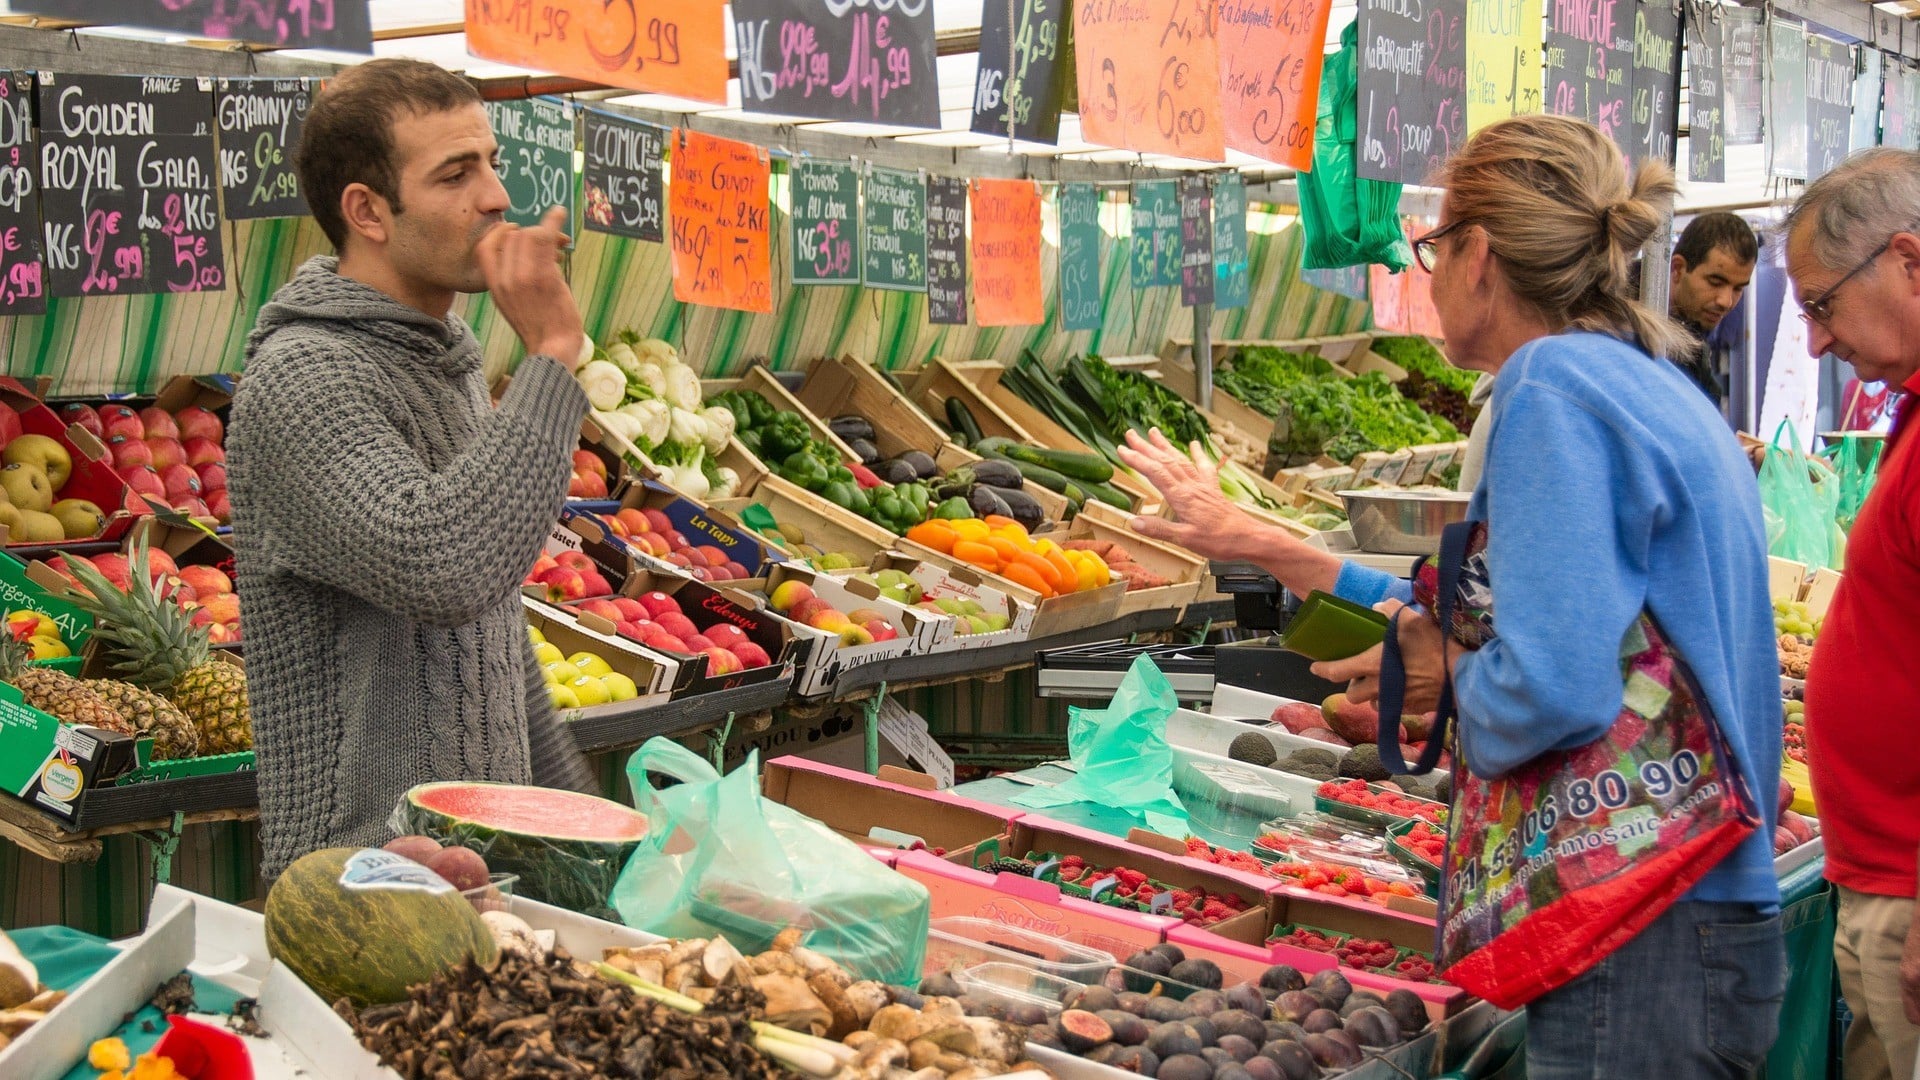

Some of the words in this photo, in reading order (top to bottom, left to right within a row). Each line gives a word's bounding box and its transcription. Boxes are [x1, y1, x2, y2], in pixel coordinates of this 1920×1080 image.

[142, 75, 182, 96] FRANCE
[975, 68, 1002, 115] KG
[59, 85, 155, 138] GOLDEN
[219, 94, 293, 147] GRANNY
[220, 148, 248, 188] KG
[594, 123, 650, 174] COMICE
[42, 141, 124, 207] ROYAL
[607, 174, 625, 205] KG
[184, 191, 217, 231] KG
[893, 207, 910, 232] KG
[45, 221, 81, 269] KG
[798, 226, 818, 262] KG
[690, 514, 708, 531] La
[708, 524, 739, 547] Tapy
[1449, 856, 1478, 908] 01
[1488, 828, 1520, 879] 53
[1523, 794, 1560, 848] 06
[1566, 769, 1630, 819] 80
[1640, 748, 1701, 798] 90
